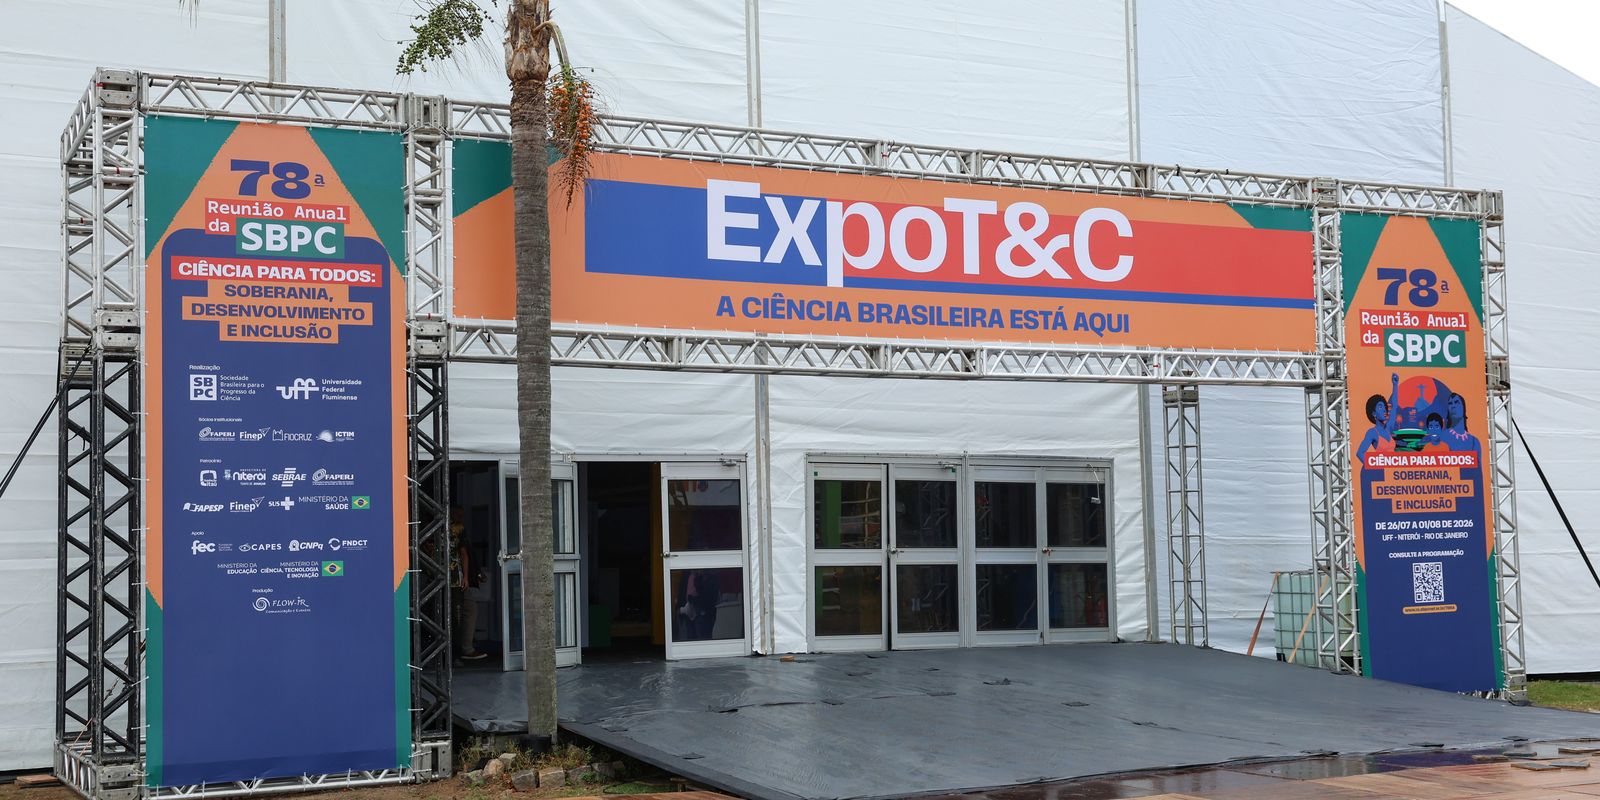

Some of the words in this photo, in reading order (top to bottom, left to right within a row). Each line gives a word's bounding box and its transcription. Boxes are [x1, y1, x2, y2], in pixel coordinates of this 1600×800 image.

[208, 201, 284, 217] Reunião
[295, 206, 346, 220] Anual
[208, 219, 230, 232] da
[242, 222, 336, 254] SBPC
[706, 179, 1134, 288] ExpoT&C
[178, 260, 253, 278] CIÊNCIA
[258, 266, 305, 280] PARA
[310, 267, 376, 282] TODOS:
[224, 284, 334, 302] SOBERANIA,
[191, 303, 365, 320] DESENVOLVIMENTO
[716, 296, 735, 317] A
[742, 293, 852, 323] CIÊNCIA
[858, 304, 1004, 329] BRASILEIRA
[1010, 306, 1067, 331] ESTÁ
[1074, 312, 1130, 338] AQUI
[1362, 312, 1420, 326] Reunião
[1427, 314, 1466, 328] Anual
[227, 324, 237, 336] E
[242, 322, 332, 339] INCLUSÃO
[1363, 330, 1380, 344] da
[1388, 333, 1460, 364] SBPC
[194, 377, 213, 387] SB
[194, 389, 213, 398] PC
[276, 378, 319, 400] uff
[240, 431, 262, 440] Finep
[1368, 454, 1408, 466] CIÊNCIA
[1410, 455, 1436, 466] PARA
[1438, 455, 1475, 465] TODOS:
[1393, 470, 1452, 481] SOBERANIA,
[1376, 484, 1470, 496] DESENVOLVIMENTO
[230, 502, 256, 512] Finep
[325, 502, 349, 510] SAÚDE
[1396, 500, 1402, 509] E
[1403, 497, 1452, 509] INCLUSÃO
[1375, 522, 1386, 530] DE
[1388, 521, 1411, 530] 26/07
[1412, 521, 1418, 529] A
[1418, 520, 1441, 529] 01/08
[1453, 519, 1473, 528] 2026
[1398, 531, 1420, 540] NITERÓI
[191, 540, 216, 555] fec
[300, 542, 324, 550] CNPq
[1423, 549, 1464, 557] PROGRAMAÇÃO
